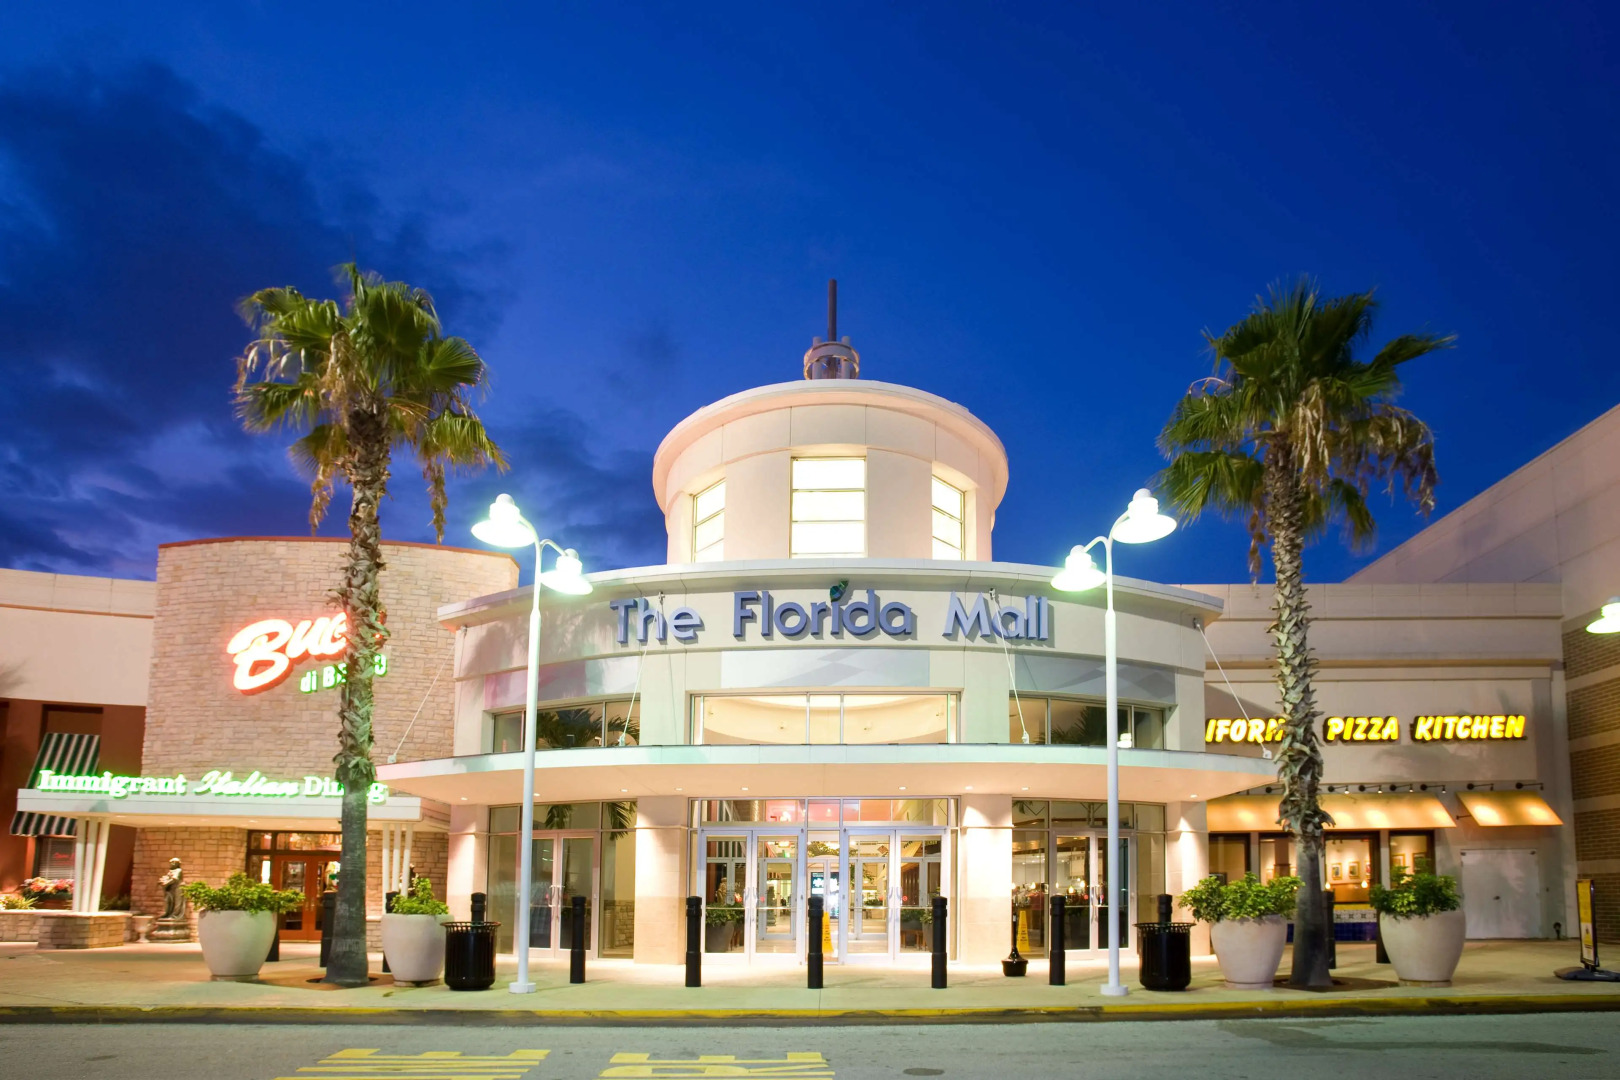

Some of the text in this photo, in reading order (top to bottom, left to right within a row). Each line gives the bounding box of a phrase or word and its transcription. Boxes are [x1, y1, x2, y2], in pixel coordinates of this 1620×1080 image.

[609, 581, 1049, 644] The Florida Mall
[300, 669, 318, 693] di
[1325, 715, 1399, 741] PIZZA
[1413, 714, 1527, 741] KITCHEN
[36, 768, 188, 798] Immigrant
[192, 770, 300, 796] Italian
